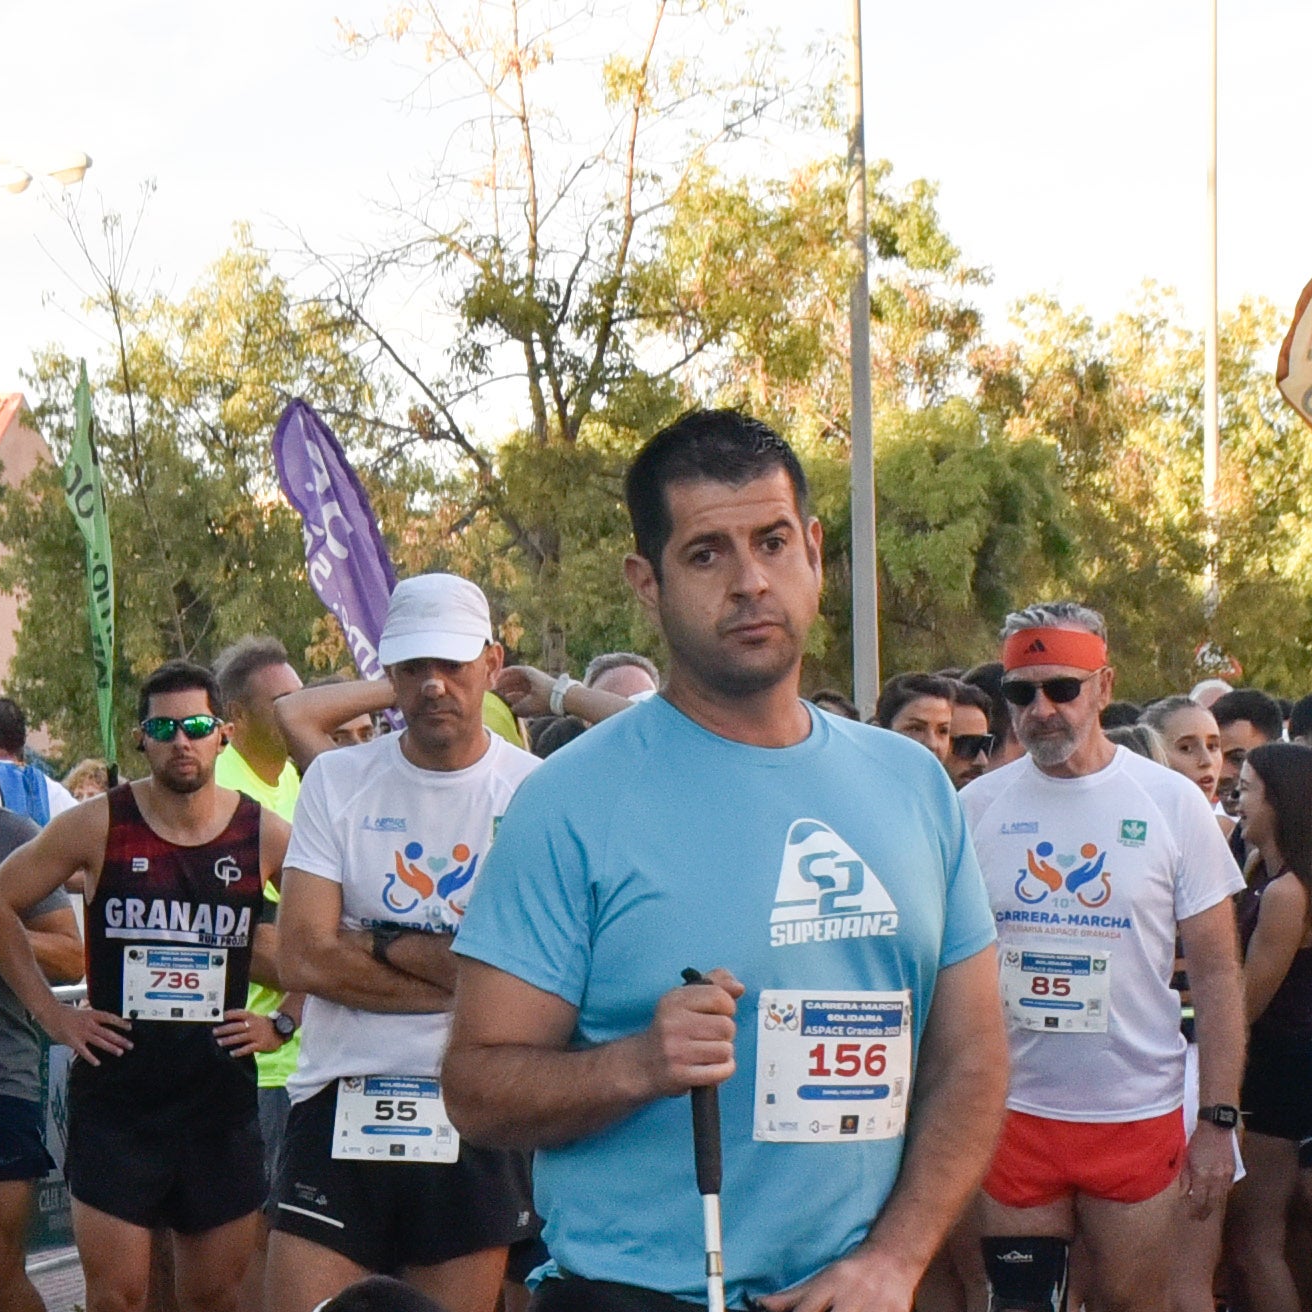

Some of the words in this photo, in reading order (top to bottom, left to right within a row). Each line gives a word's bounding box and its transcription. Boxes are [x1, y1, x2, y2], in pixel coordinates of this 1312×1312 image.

[105, 897, 251, 936] GRANADA
[769, 912, 899, 948] SUPERAN2
[150, 970, 200, 990] 736
[1030, 976, 1071, 997] 85
[826, 1013, 884, 1023] SOLIDARIA
[804, 1025, 845, 1036] ASPACE
[846, 1025, 884, 1037] Granada
[808, 1043, 888, 1079] 156
[374, 1099, 419, 1122] 55
